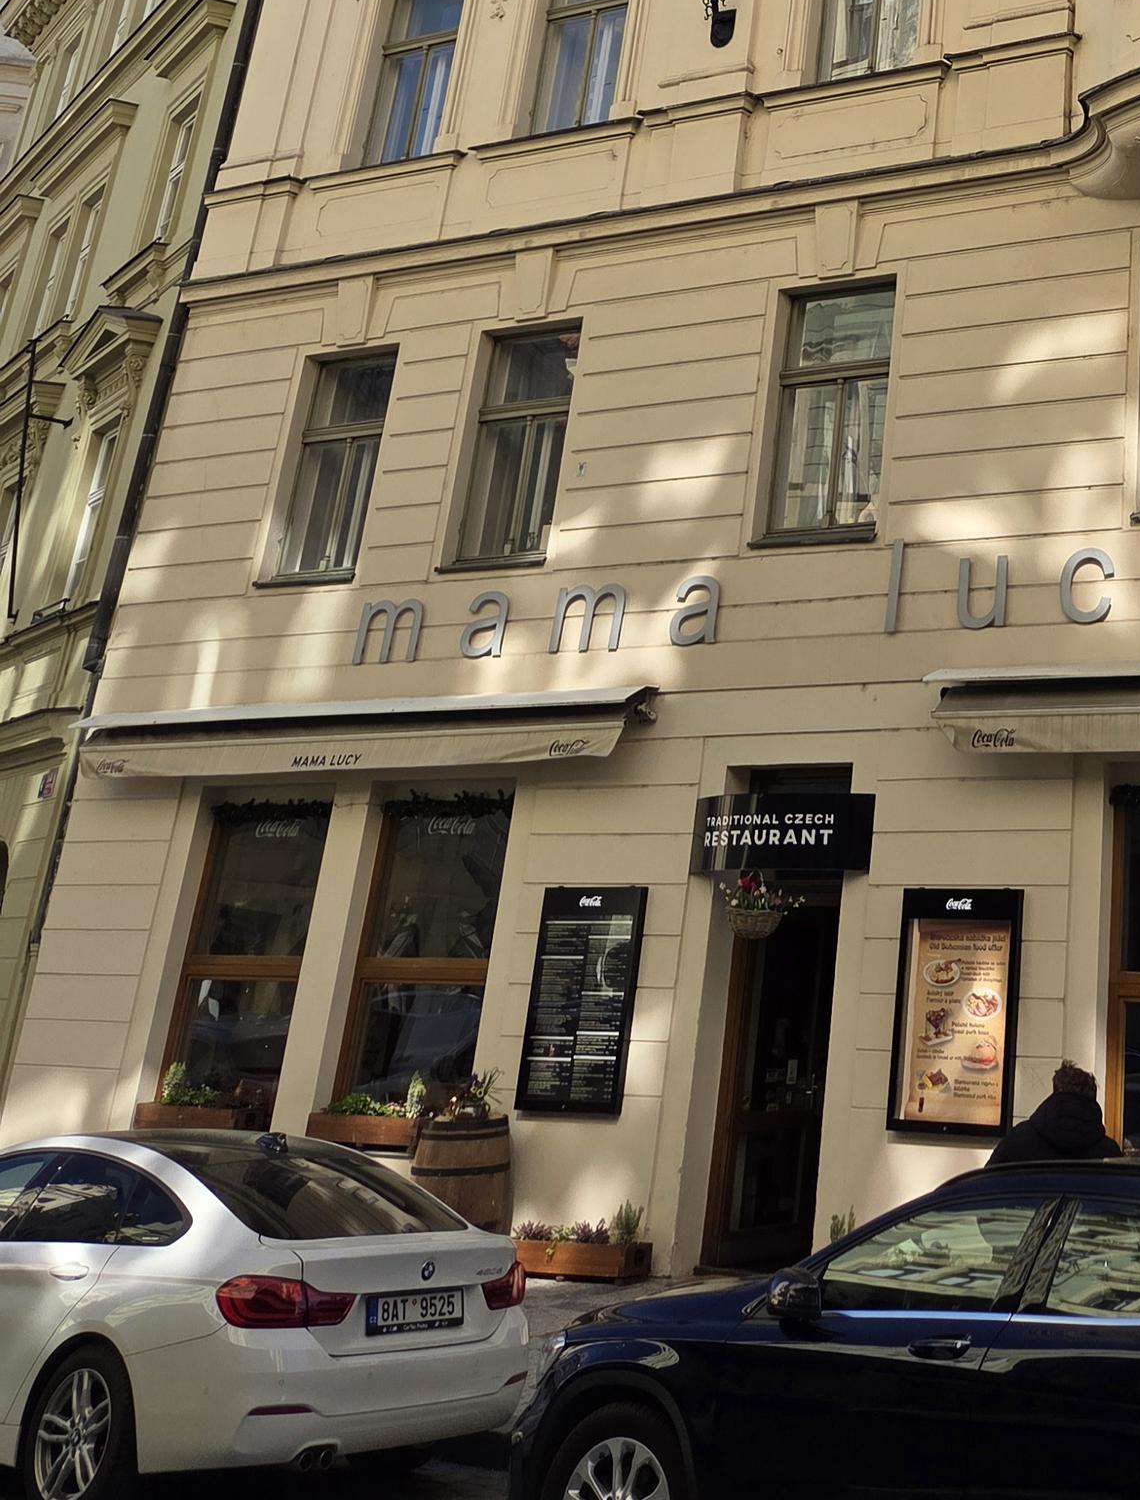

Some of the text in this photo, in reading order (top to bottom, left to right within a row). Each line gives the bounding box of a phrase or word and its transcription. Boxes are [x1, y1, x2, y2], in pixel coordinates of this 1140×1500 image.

[352, 575, 721, 666] mama
[291, 753, 362, 768] MAMA LUCY
[706, 813, 834, 827] TRADITIONAL CZECH
[704, 829, 833, 847] RESTAURANT
[382, 1294, 455, 1322] 8AT 9525
